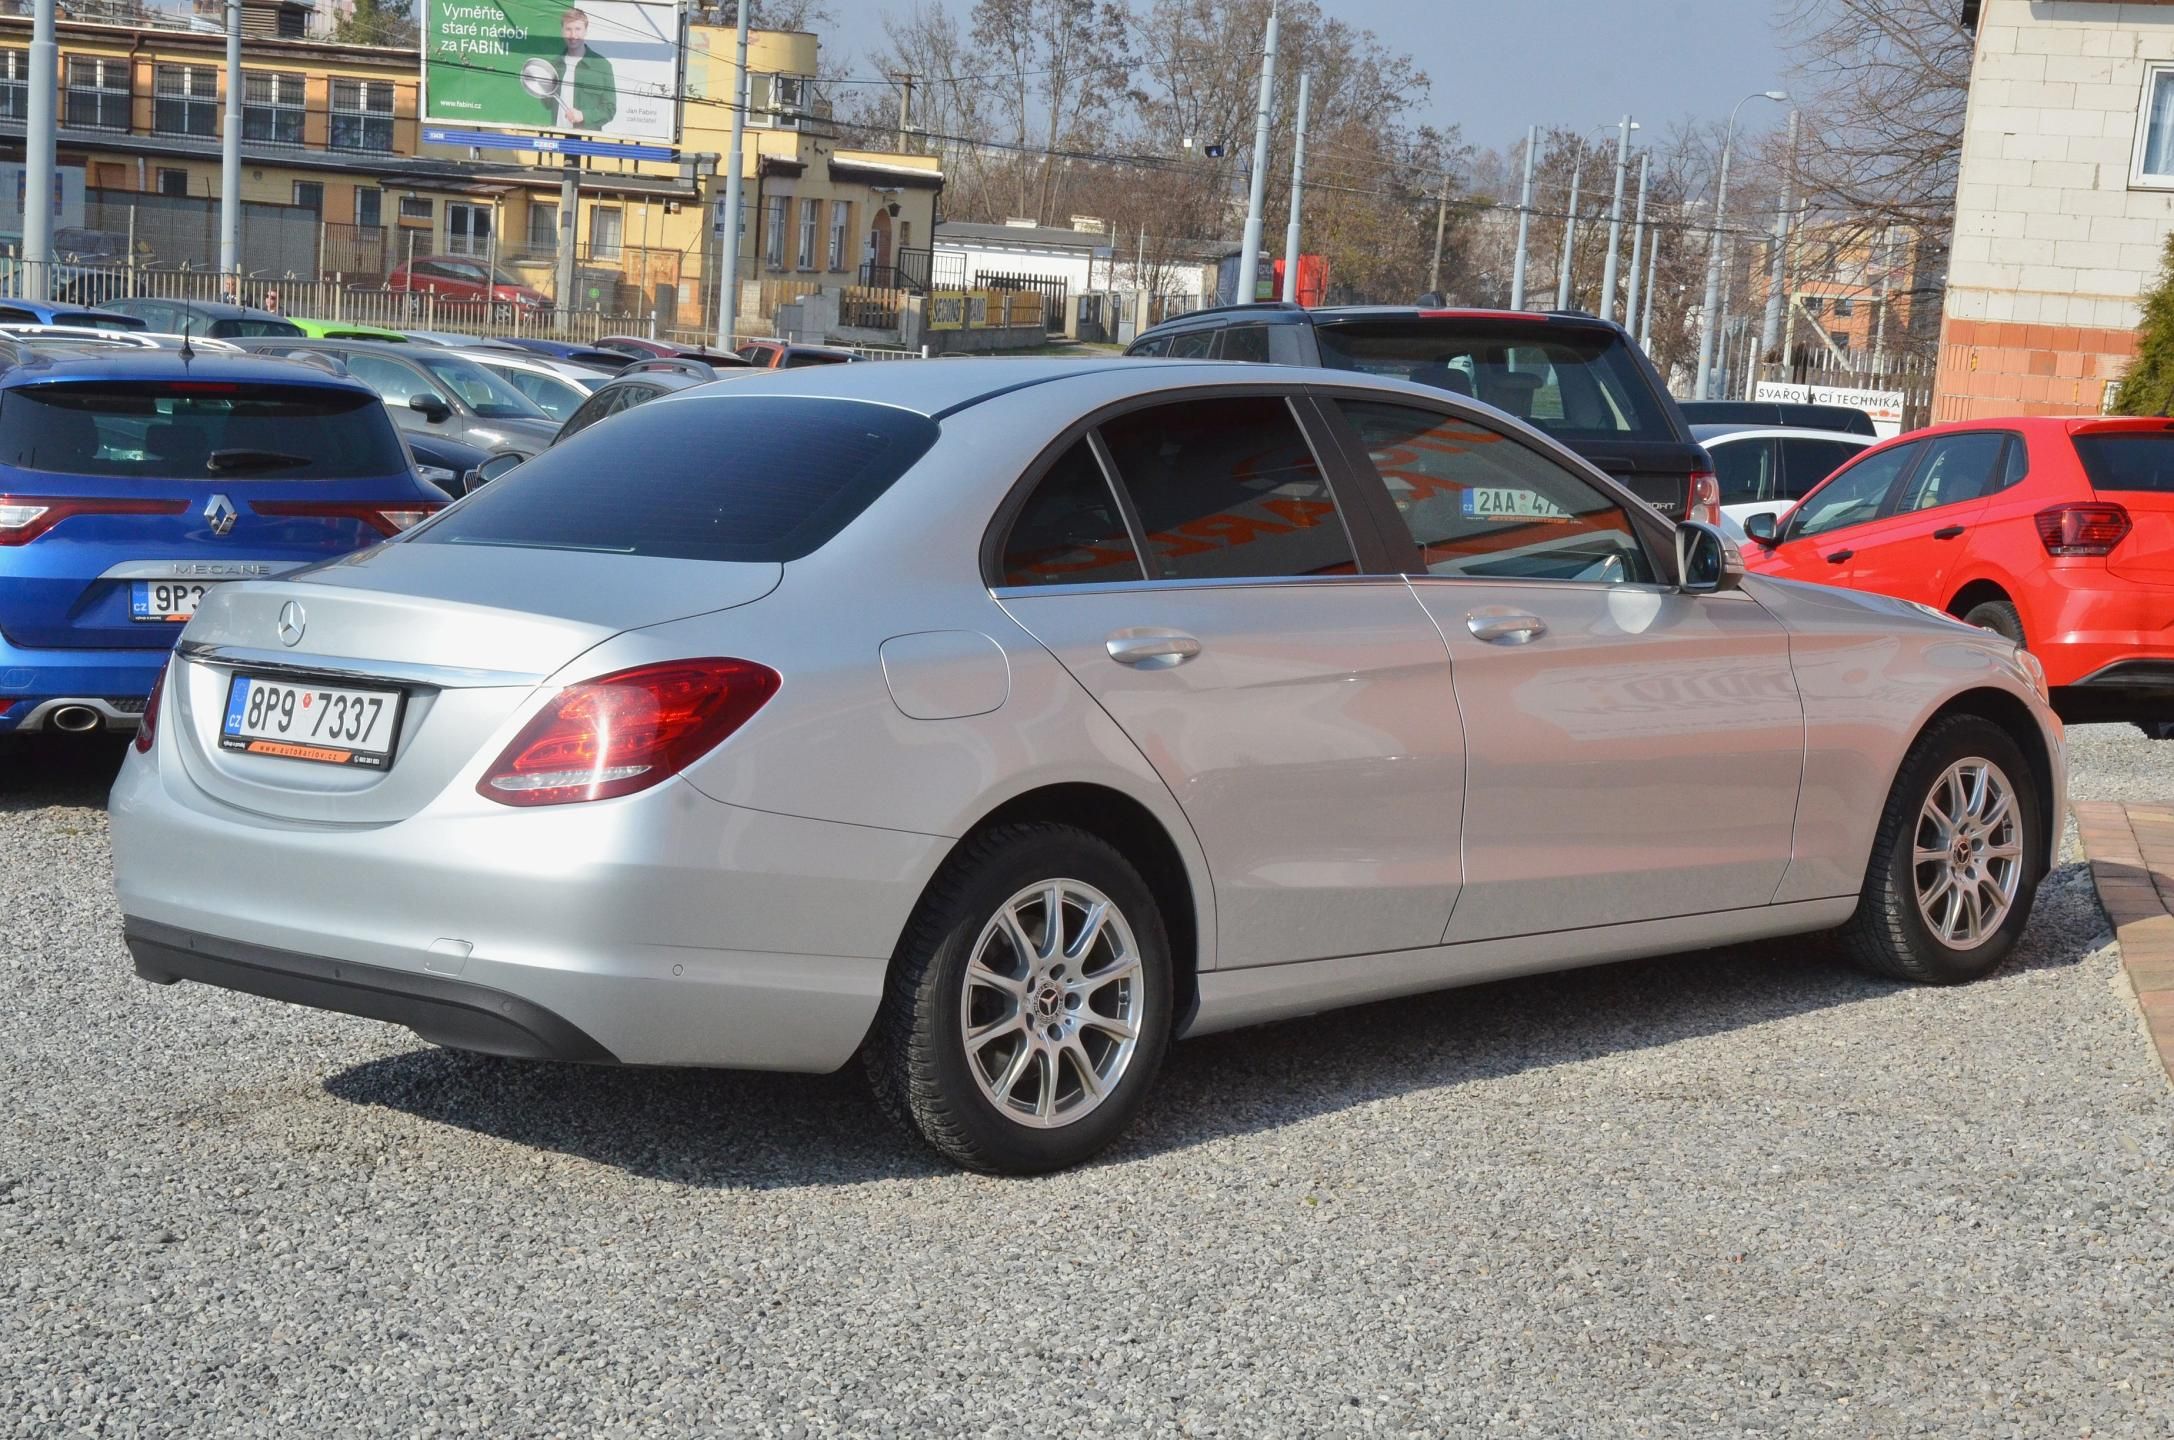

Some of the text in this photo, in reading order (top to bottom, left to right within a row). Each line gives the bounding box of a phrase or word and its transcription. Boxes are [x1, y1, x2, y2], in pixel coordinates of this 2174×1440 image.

[442, 2, 504, 20] Vyměňte
[442, 21, 528, 40] staré nádobí
[441, 38, 509, 56] za FABINI
[440, 100, 482, 110] www.fabini.cz
[1837, 394, 1900, 409] TECHNIKA
[1480, 491, 1516, 512] 2AA
[133, 603, 148, 612] CZ
[228, 715, 241, 728] CZ
[247, 686, 383, 743] 8P9 7337
